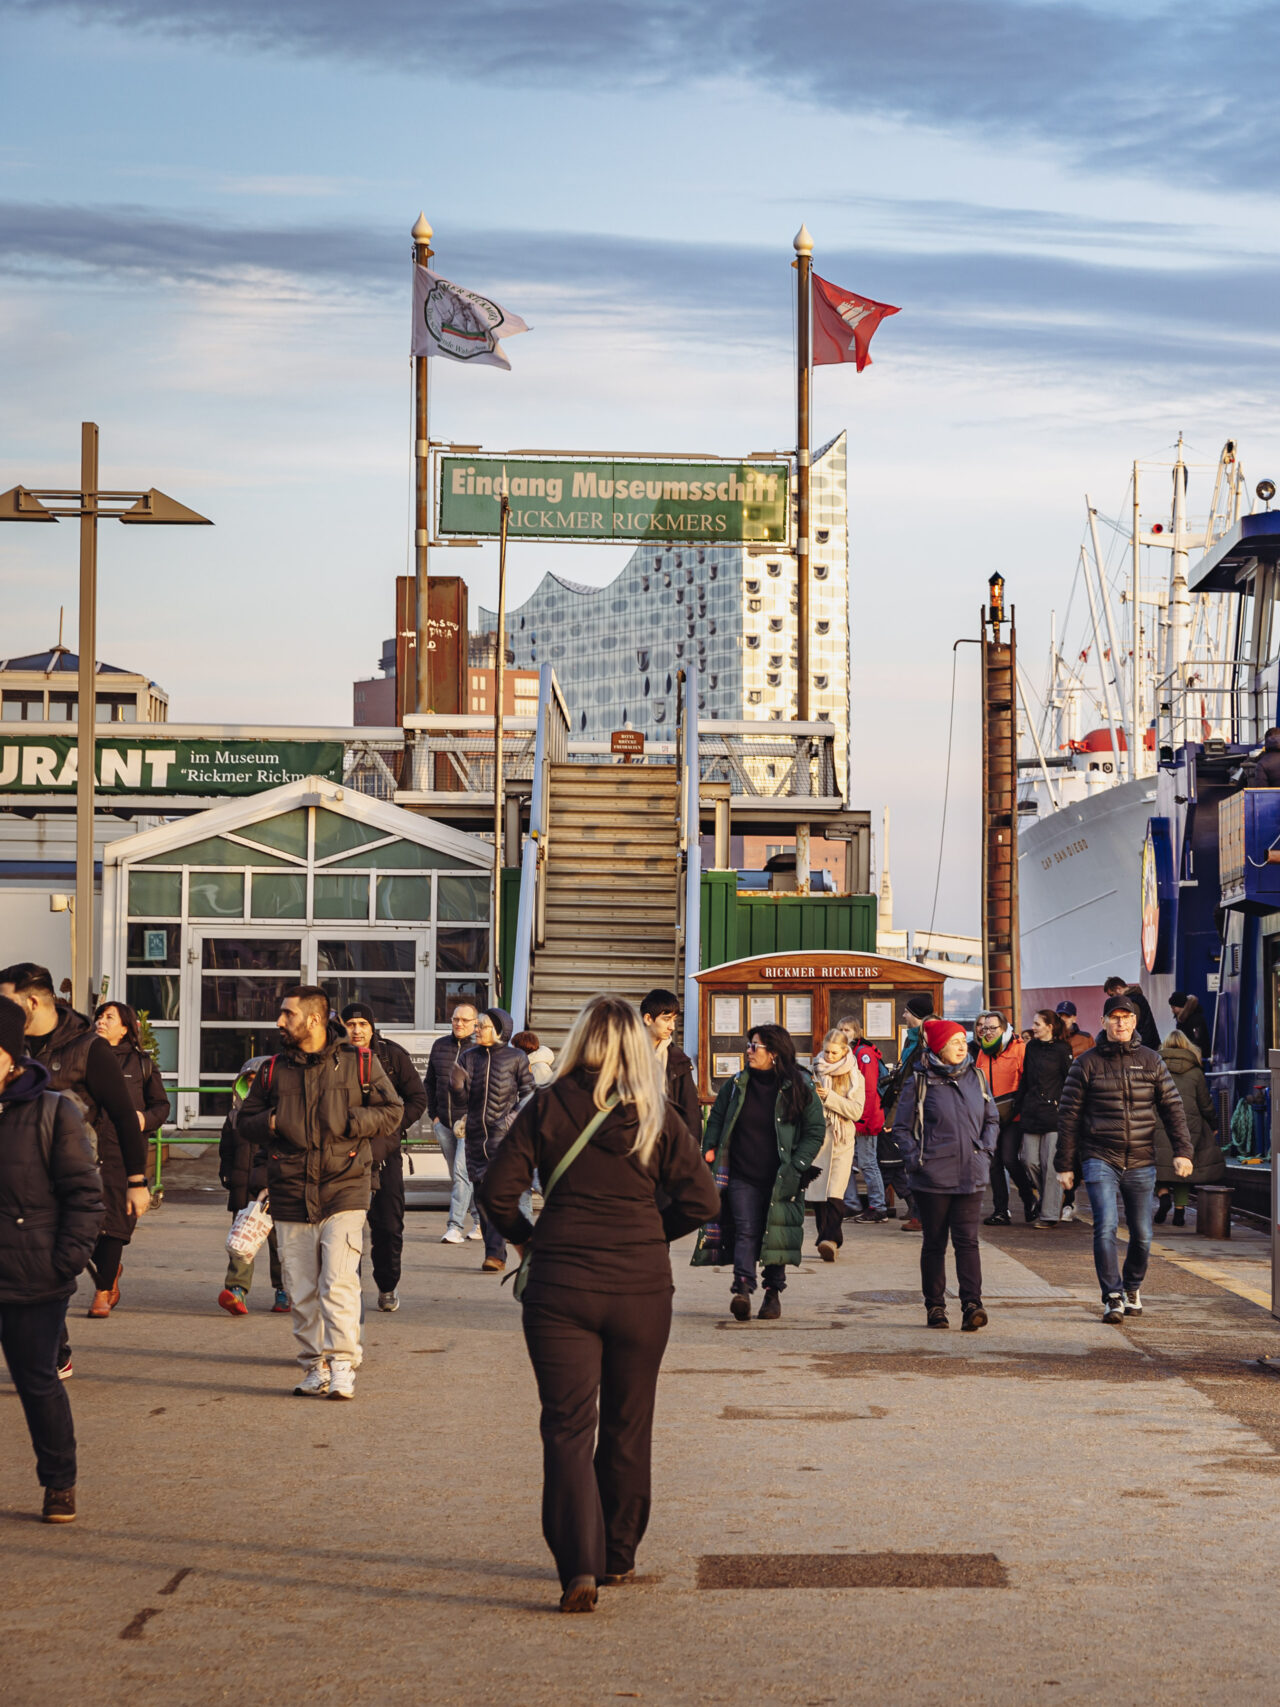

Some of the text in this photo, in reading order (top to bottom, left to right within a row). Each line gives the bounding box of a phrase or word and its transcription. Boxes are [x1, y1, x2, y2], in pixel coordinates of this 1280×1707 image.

[452, 467, 778, 503] Eingang Museumsschiff
[612, 512, 727, 532] RICKMERS
[190, 751, 280, 764] im Museum
[1041, 838, 1089, 871] CAP SAN DIEGO
[765, 967, 879, 978] RICKMER RICKMERS
